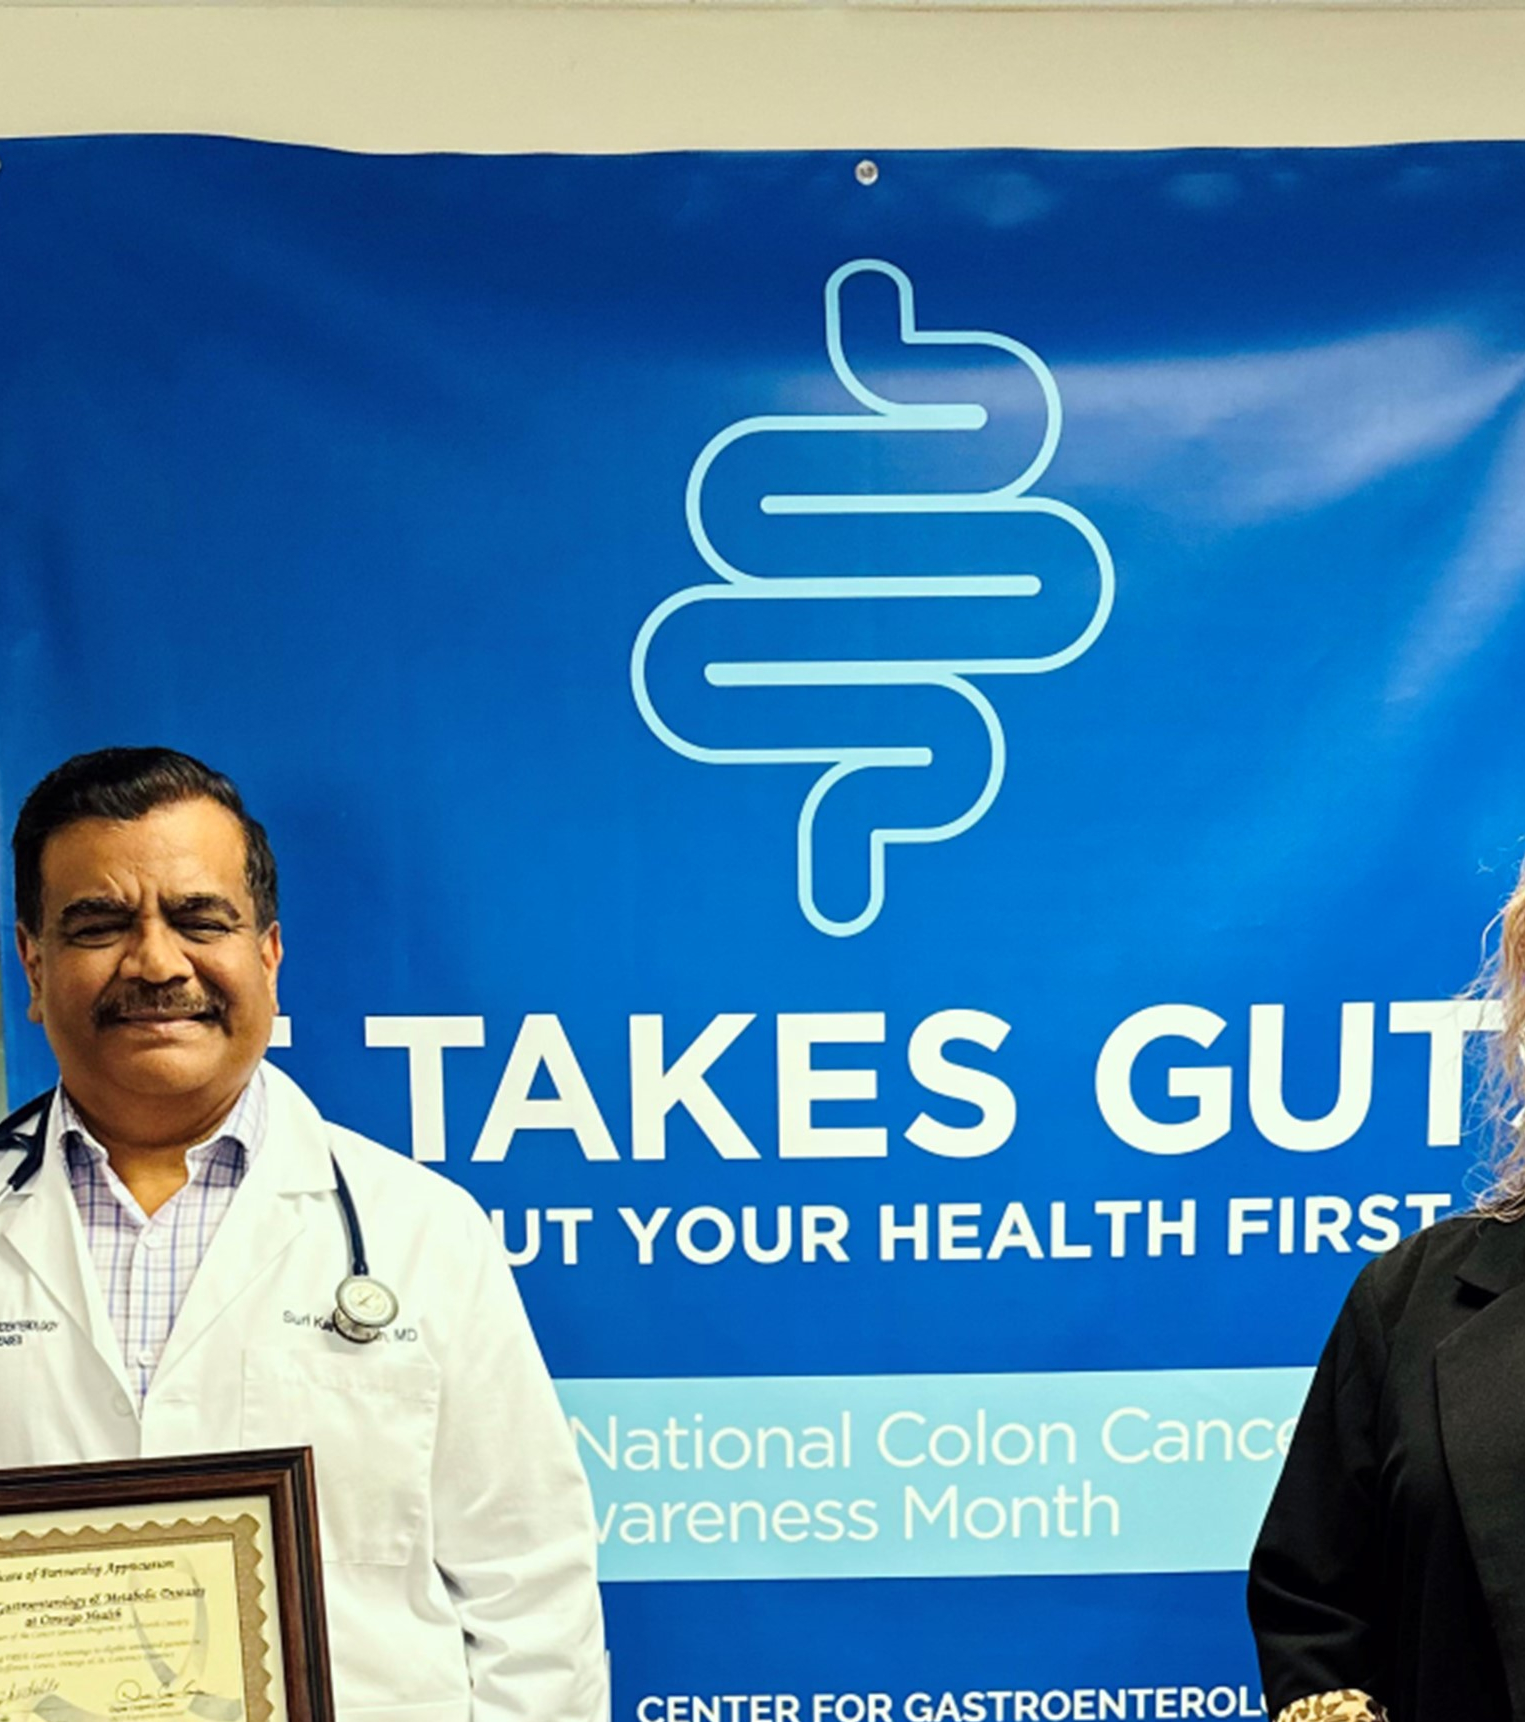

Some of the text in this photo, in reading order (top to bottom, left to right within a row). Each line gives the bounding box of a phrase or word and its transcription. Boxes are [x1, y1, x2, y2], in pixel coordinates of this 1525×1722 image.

[364, 999, 1507, 1163] TAKES GUT
[489, 1193, 1453, 1267] UT YOUR HEALTH FIRST
[568, 1406, 1300, 1472] National Colon Cance
[592, 1479, 1121, 1545] areness Month
